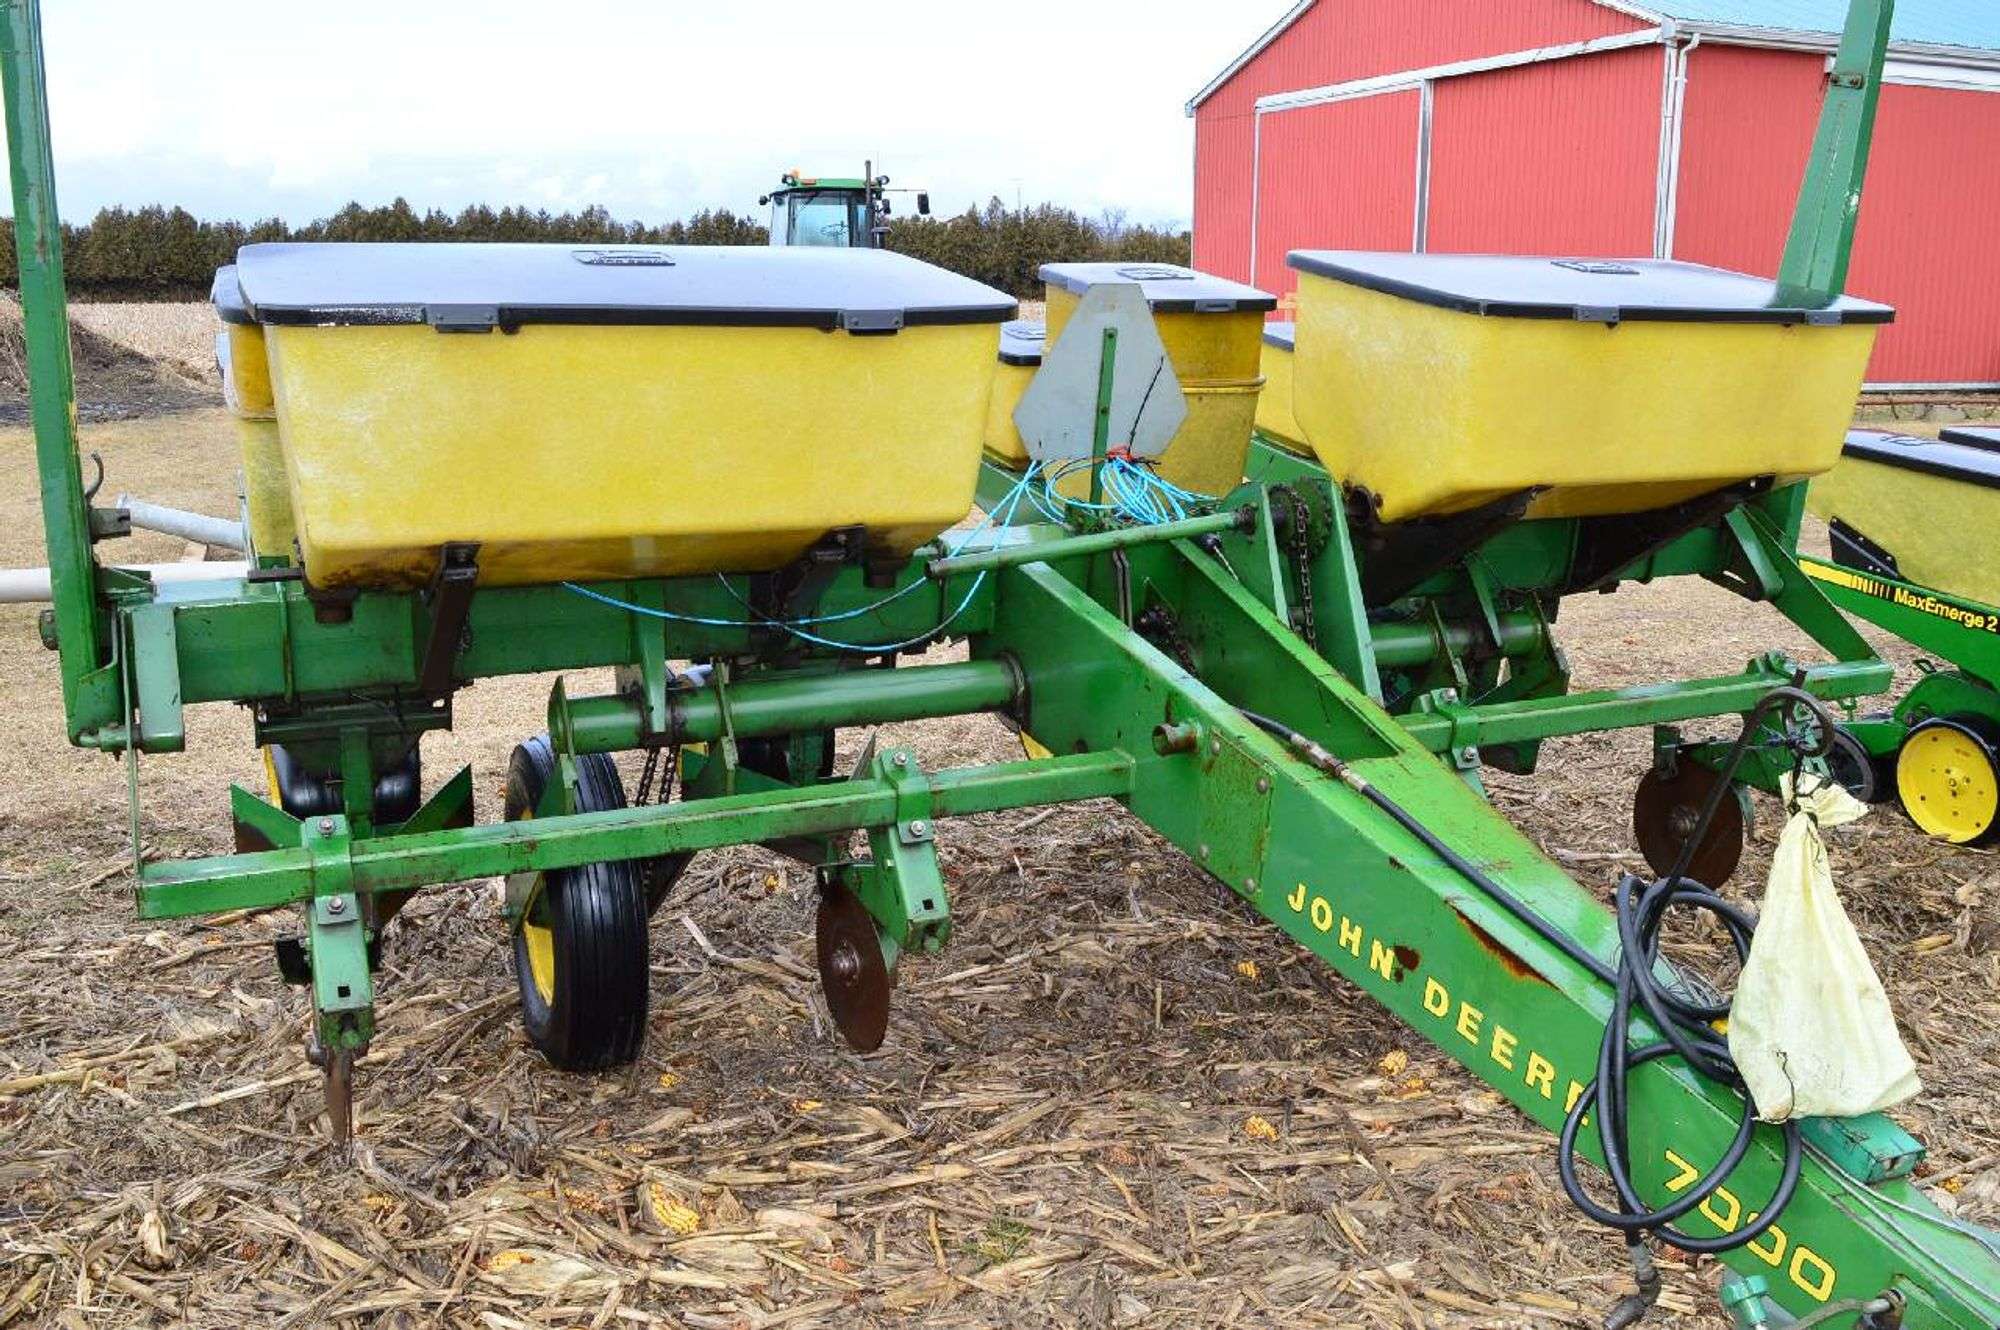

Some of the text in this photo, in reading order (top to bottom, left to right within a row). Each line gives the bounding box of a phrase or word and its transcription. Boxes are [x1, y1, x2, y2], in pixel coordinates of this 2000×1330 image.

[1893, 587, 1998, 633] MaxEmerge 2
[1286, 882, 1395, 981] JOHN
[1663, 1148, 1837, 1303] 7000
